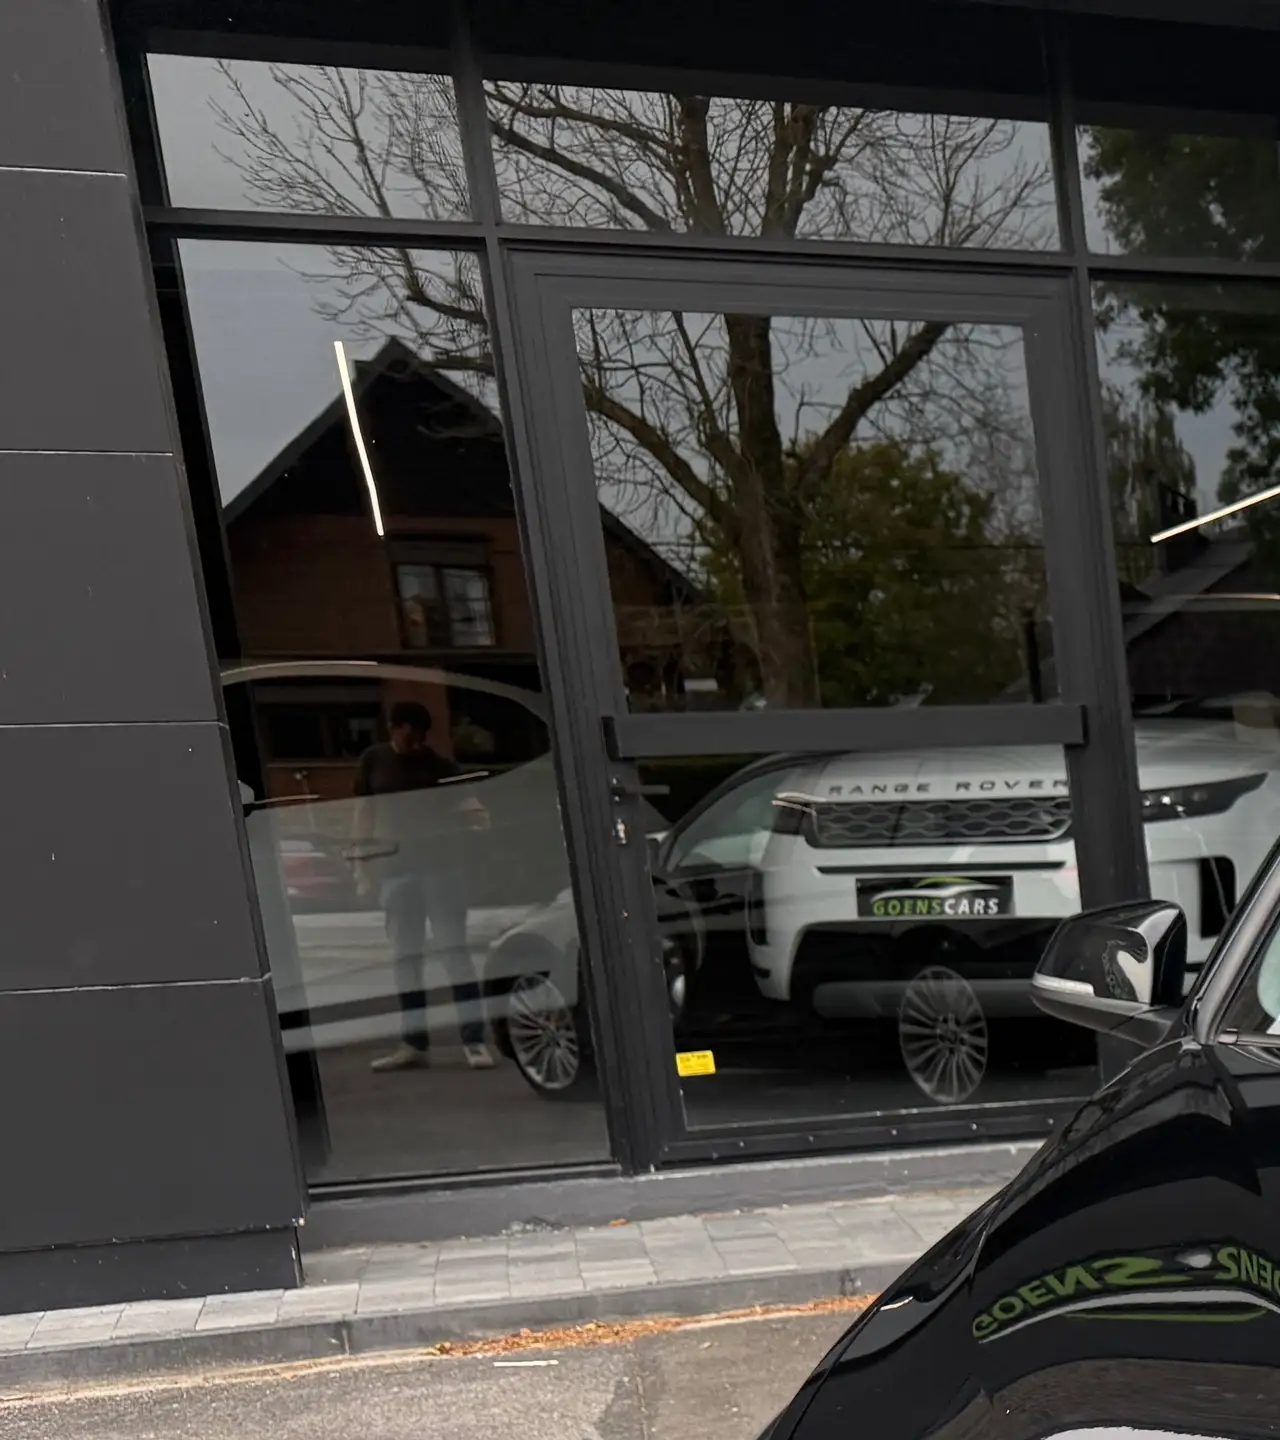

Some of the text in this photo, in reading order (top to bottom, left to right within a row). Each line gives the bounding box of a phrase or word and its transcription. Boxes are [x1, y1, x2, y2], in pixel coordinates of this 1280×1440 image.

[828, 780, 1068, 795] RANGE ROVER
[873, 898, 999, 916] GOENSCARS
